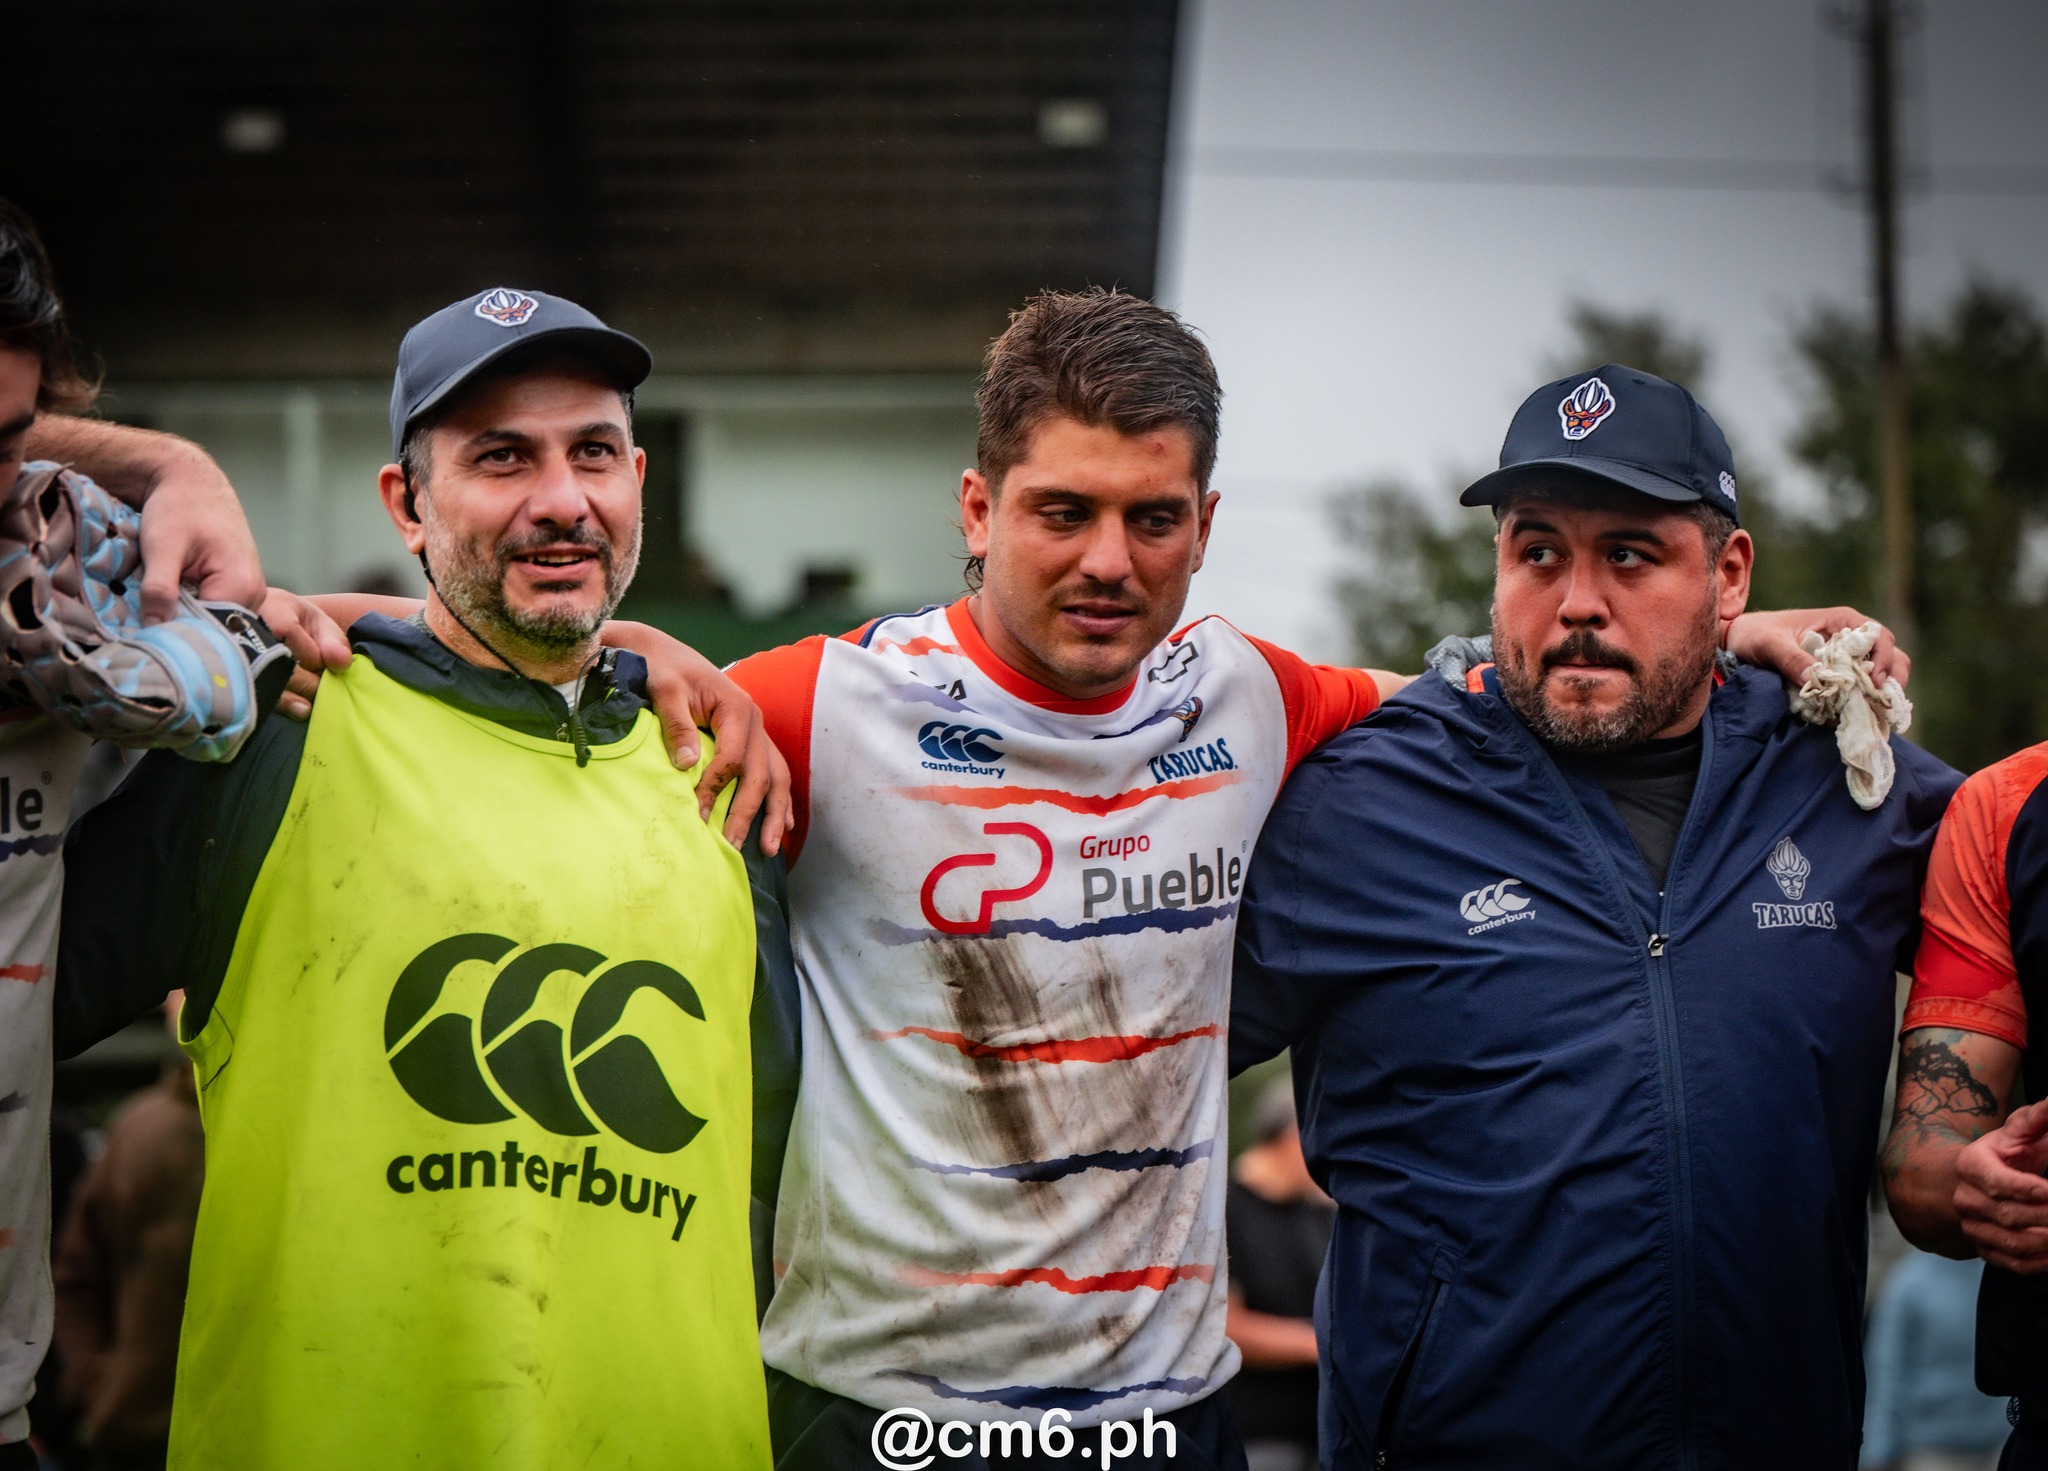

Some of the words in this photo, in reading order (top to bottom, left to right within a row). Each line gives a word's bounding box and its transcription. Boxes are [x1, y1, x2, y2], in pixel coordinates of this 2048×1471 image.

[921, 761, 1006, 779] canterbury
[1080, 835, 1150, 861] Grupo
[1082, 848, 1241, 918] Pueble
[1467, 910, 1536, 936] canterbury
[386, 1140, 698, 1242] canterbury
